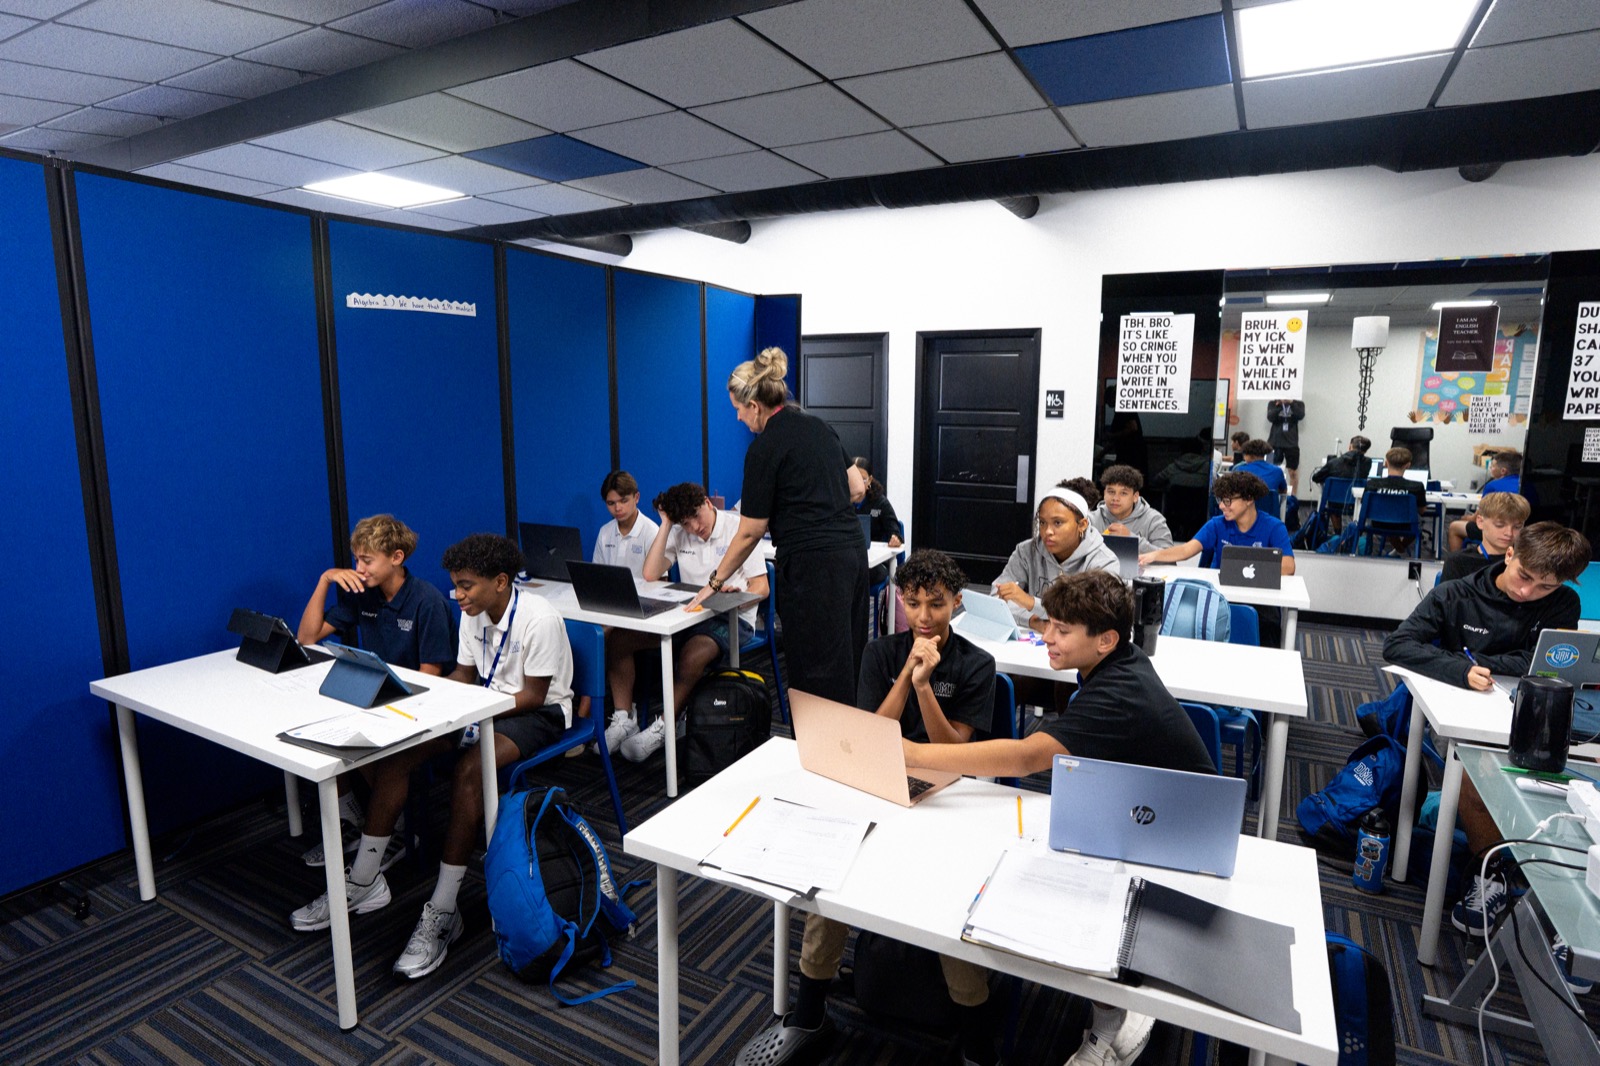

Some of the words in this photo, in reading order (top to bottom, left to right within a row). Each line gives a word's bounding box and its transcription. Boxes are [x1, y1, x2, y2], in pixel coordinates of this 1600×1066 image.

[1124, 318, 1146, 328] TBH.
[1149, 318, 1173, 328] BRO.
[1245, 319, 1279, 330] BRUH.
[1578, 323, 1600, 334] SH
[1123, 330, 1142, 339] IT'S
[1146, 330, 1169, 339] LIKE
[1244, 332, 1261, 342] MY
[1266, 331, 1286, 342] ICK
[1123, 341, 1137, 351] SO
[1140, 341, 1178, 351] CRINGE
[1243, 344, 1254, 354] IS
[1259, 343, 1294, 354] WHEN
[1576, 339, 1600, 350] CA
[1122, 353, 1153, 363] WHEN
[1156, 353, 1177, 363] YOU
[1242, 356, 1250, 366] U
[1255, 356, 1285, 366] TALK
[1574, 355, 1594, 366] 37
[1121, 365, 1160, 375] FORGET
[1164, 365, 1177, 375] TO
[1242, 368, 1278, 378] WHILE
[1282, 368, 1297, 378] I'M
[1121, 376, 1153, 386] WRITE
[1157, 377, 1167, 386] IN
[1242, 380, 1291, 390] TALKING
[1120, 388, 1174, 398] COMPLETE
[1119, 399, 1180, 410] SENTENCES.
[1463, 624, 1483, 633] CRAFT
